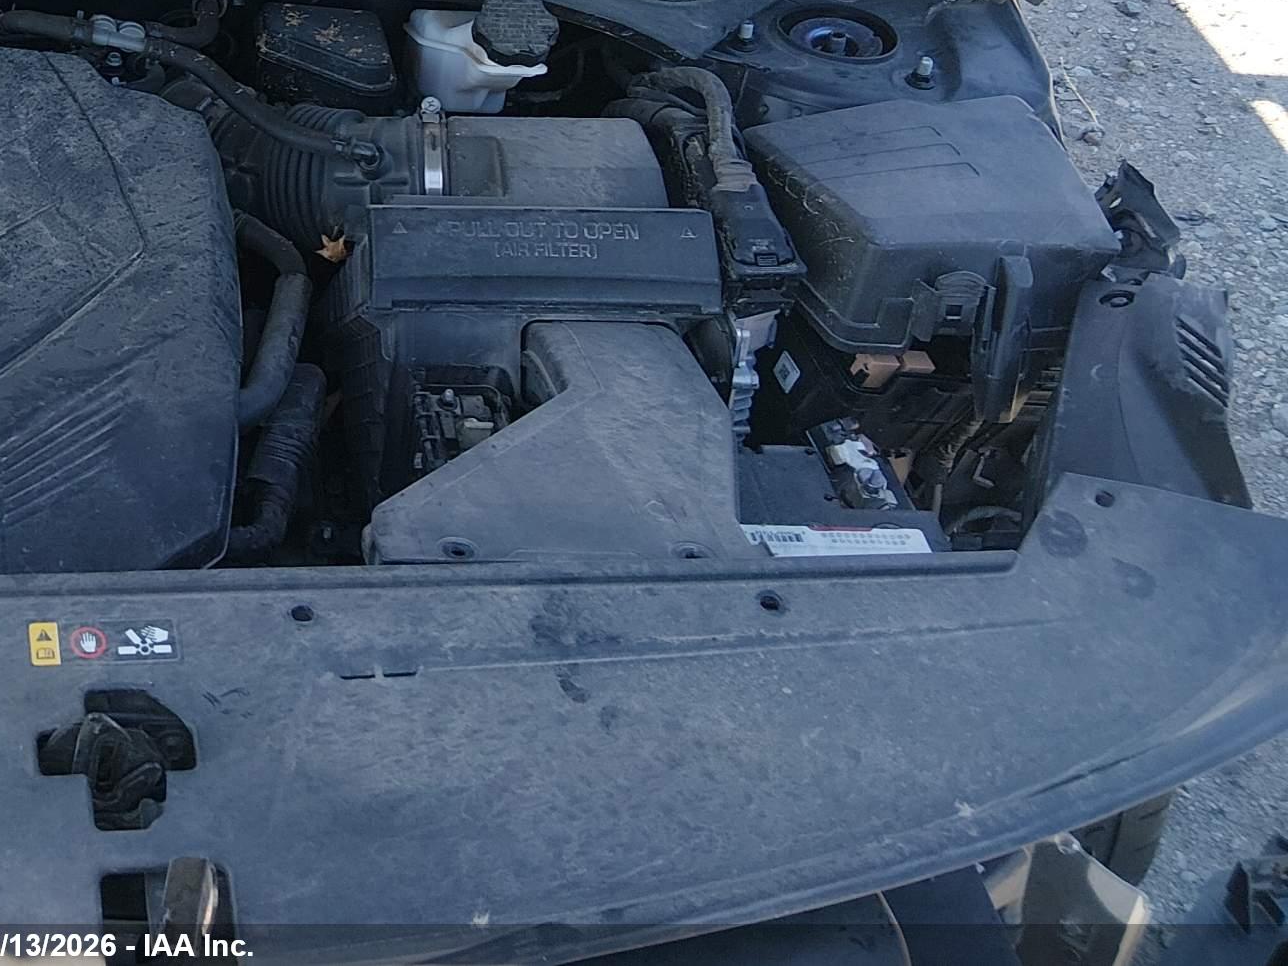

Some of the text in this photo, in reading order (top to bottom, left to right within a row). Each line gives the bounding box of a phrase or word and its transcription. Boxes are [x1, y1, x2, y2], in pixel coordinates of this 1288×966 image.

[504, 221, 547, 238] OUT
[550, 222, 579, 239] TO
[583, 222, 640, 240] OPEN
